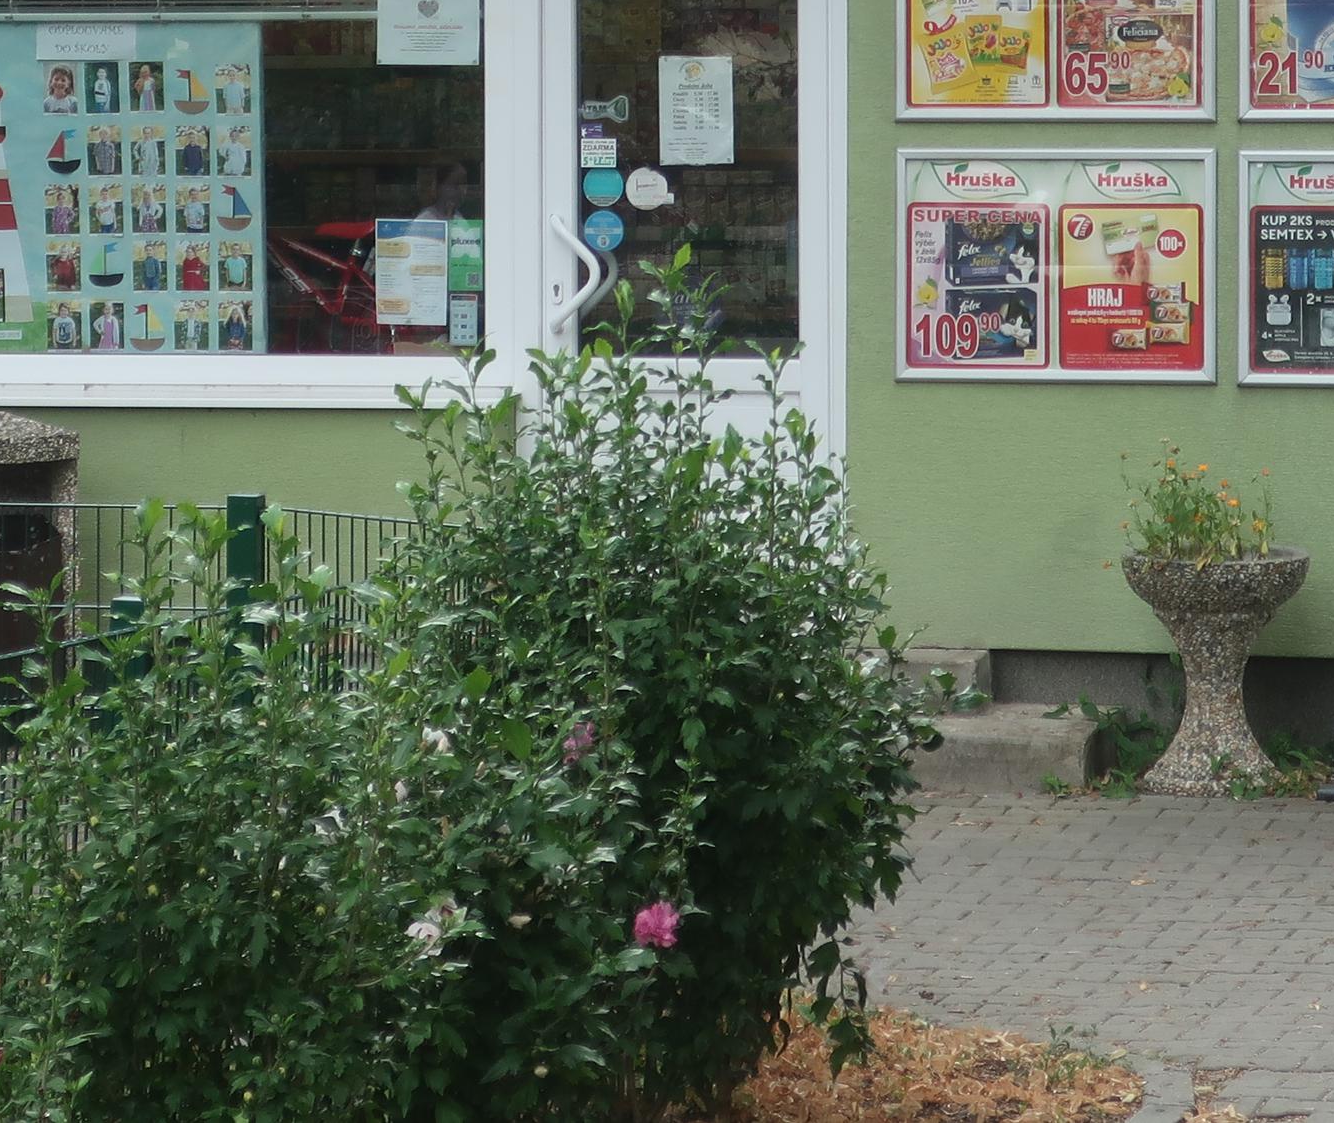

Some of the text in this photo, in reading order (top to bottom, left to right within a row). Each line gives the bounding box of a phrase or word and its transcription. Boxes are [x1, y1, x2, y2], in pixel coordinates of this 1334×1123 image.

[1123, 28, 1158, 36] Feliciana
[1065, 52, 1130, 96] 65 90
[1258, 51, 1323, 94] 21 90
[946, 171, 1015, 186] Hruška
[1097, 172, 1168, 187] Hruška
[914, 210, 1041, 222] SUPER CENA
[1261, 216, 1287, 226] KUP
[1290, 216, 1312, 226] 2KS
[451, 237, 481, 246] pluxee
[1261, 230, 1313, 240] SEMTEX
[1088, 288, 1123, 307] HRAJ
[915, 313, 1000, 357] 109 90
